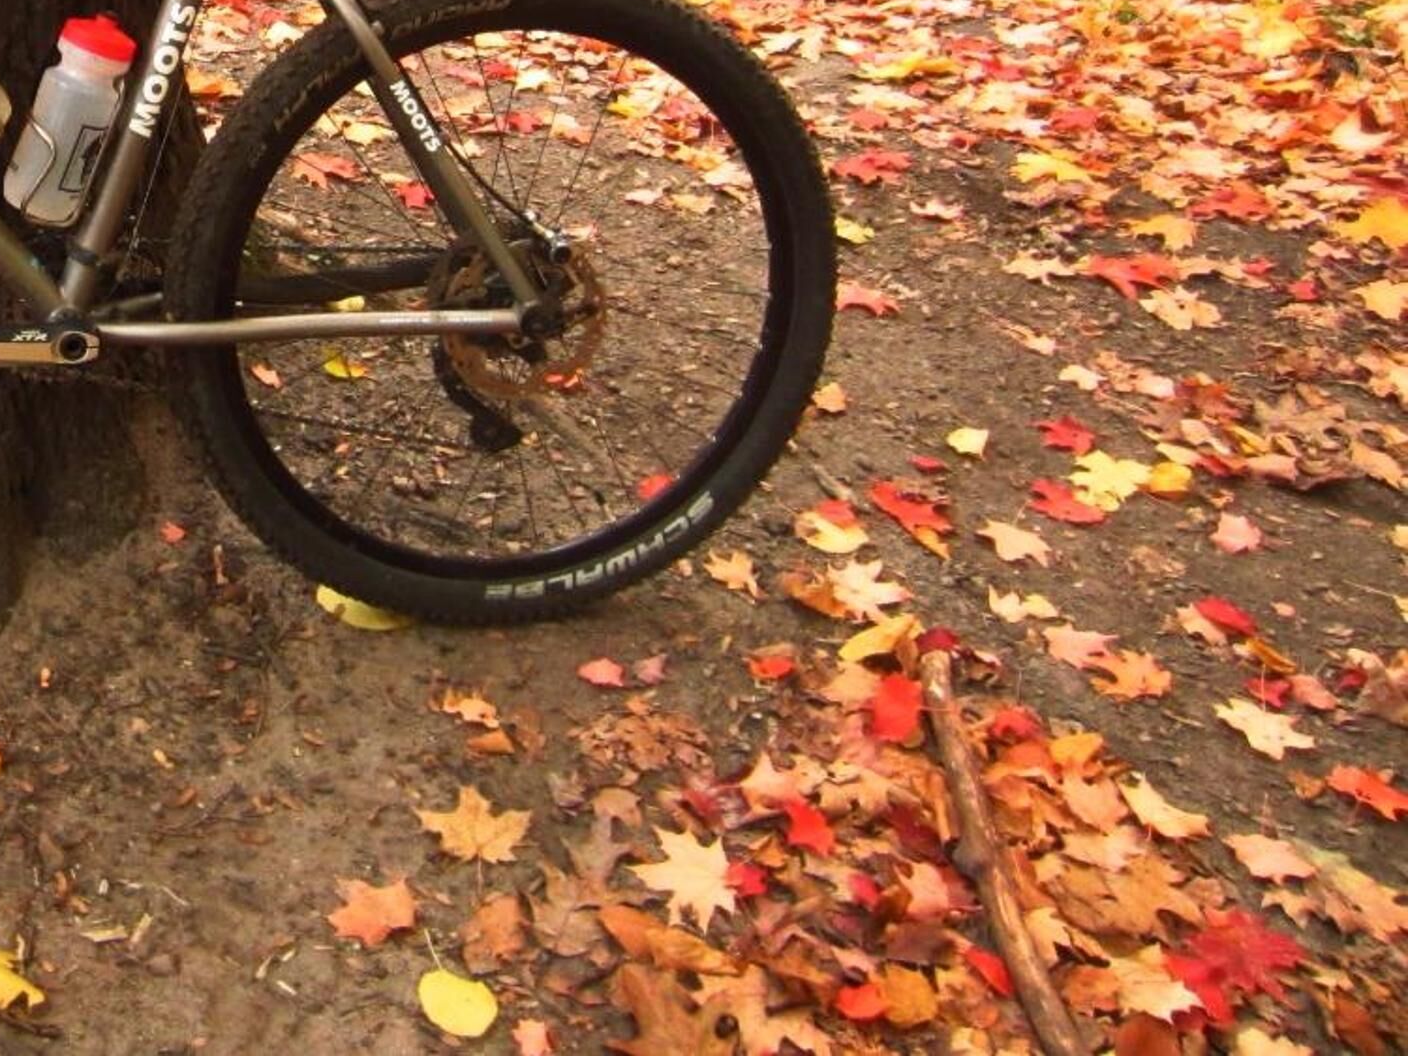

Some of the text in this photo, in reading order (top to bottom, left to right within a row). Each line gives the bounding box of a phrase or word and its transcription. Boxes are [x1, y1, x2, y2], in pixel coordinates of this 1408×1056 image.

[128, 2, 196, 138] MOOTS
[389, 80, 442, 152] MOOTS
[485, 490, 714, 600] SCHWALBE
